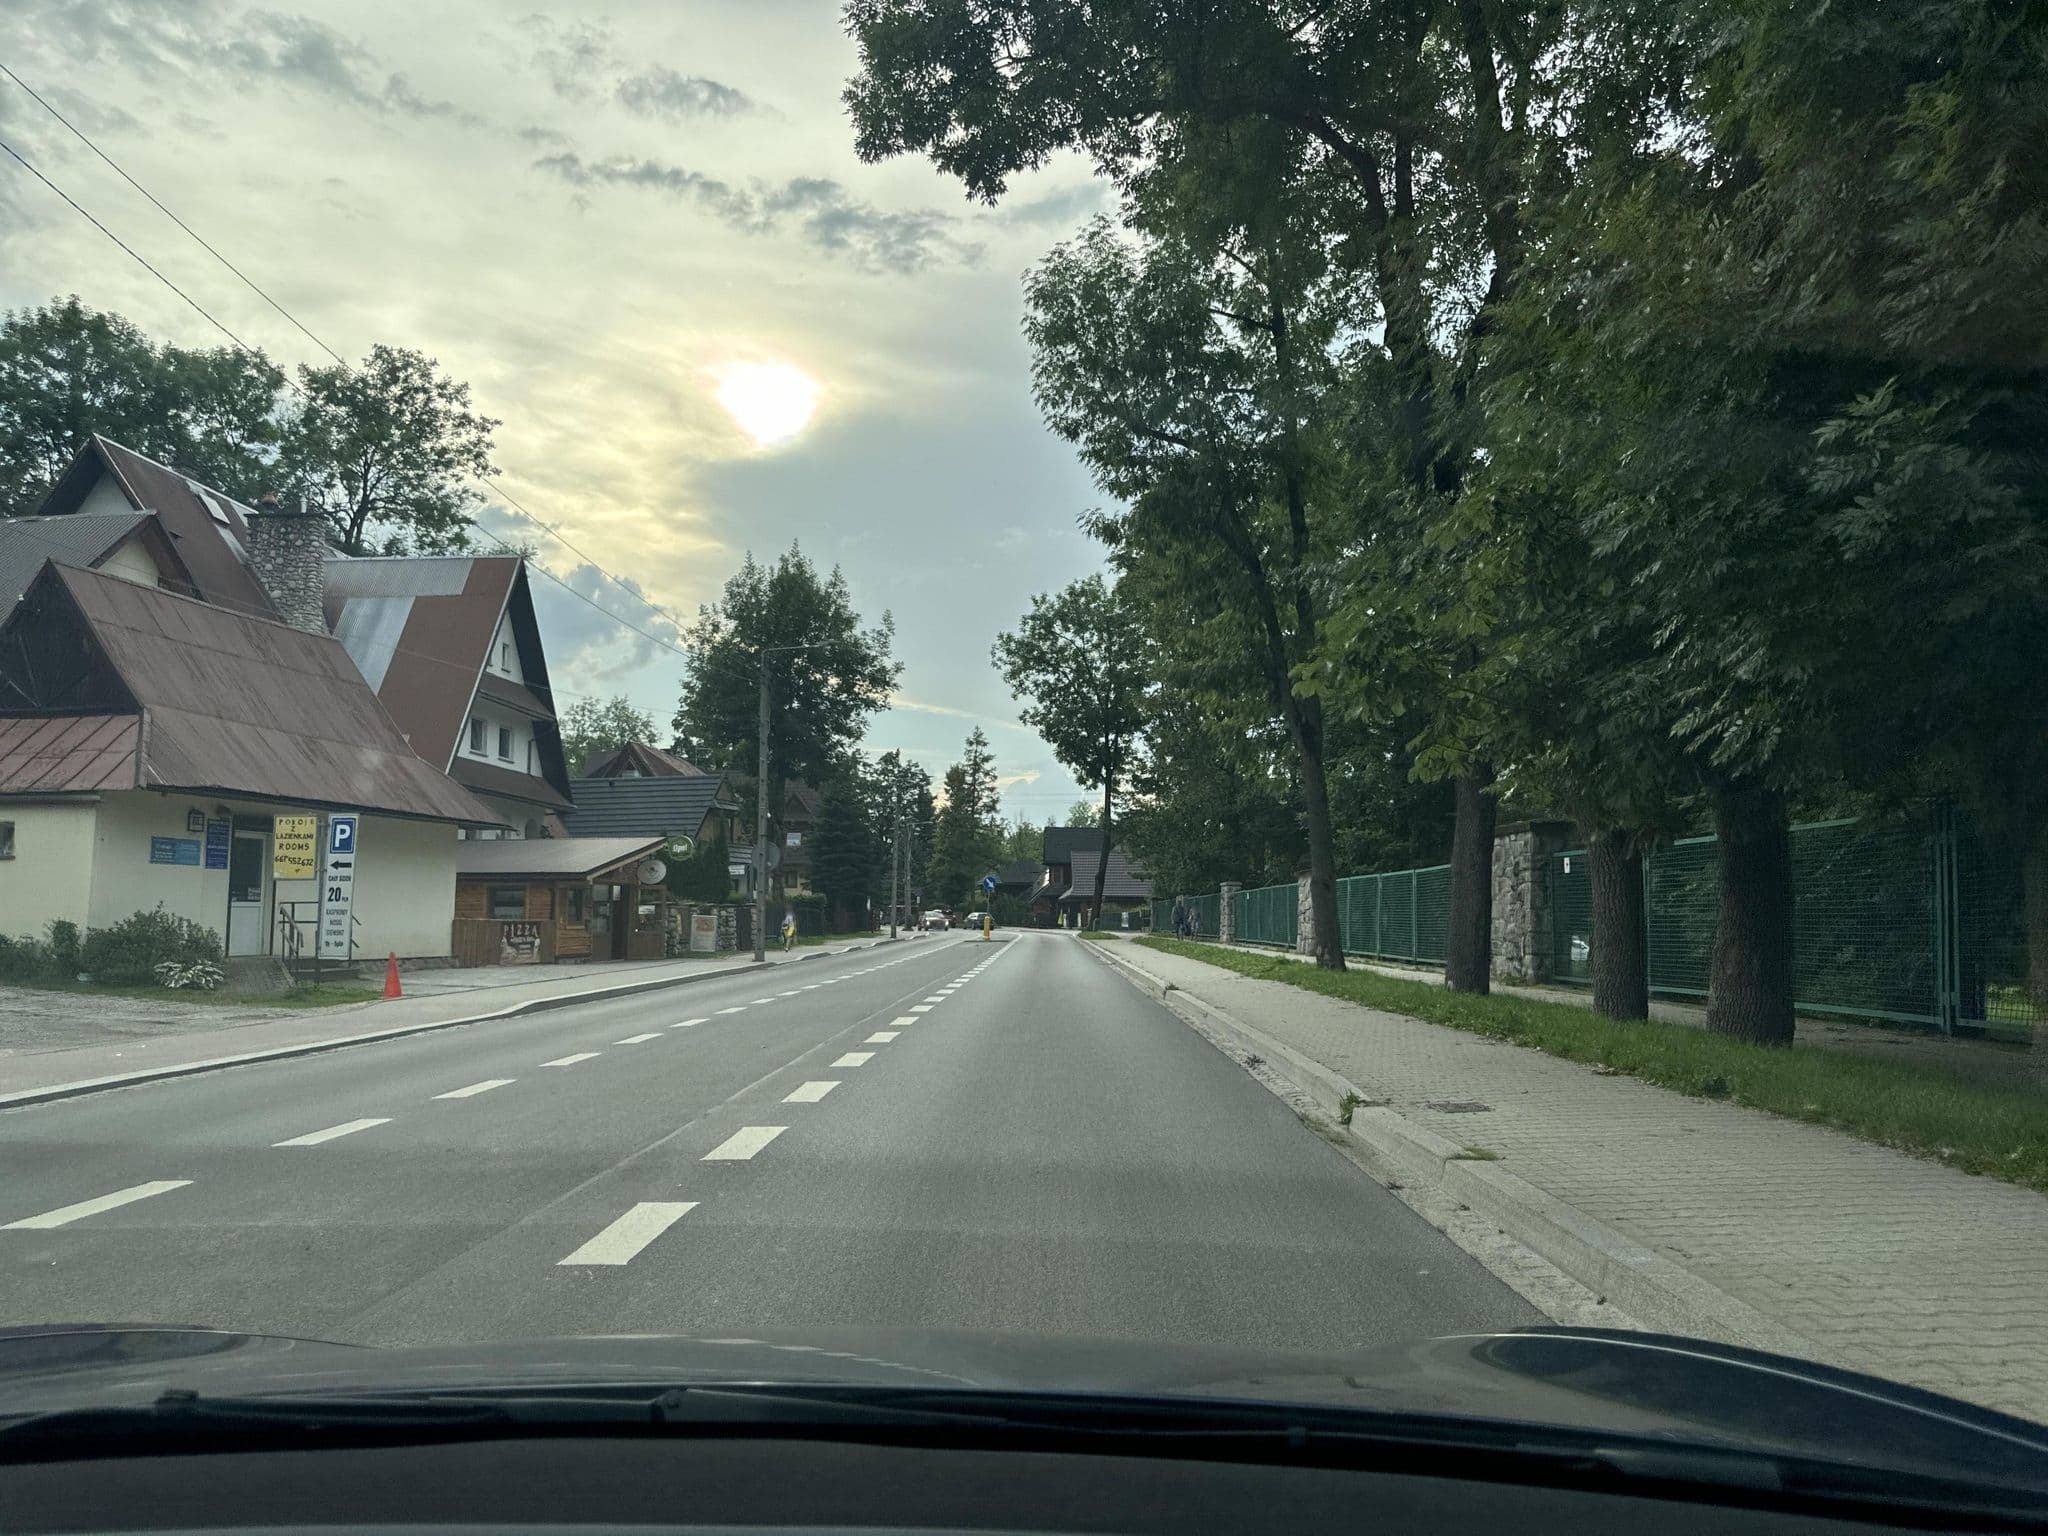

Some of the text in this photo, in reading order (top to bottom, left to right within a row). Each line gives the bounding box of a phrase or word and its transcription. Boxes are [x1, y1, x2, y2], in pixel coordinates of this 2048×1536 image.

[335, 824, 351, 847] P
[278, 842, 310, 851] ROOMS
[328, 887, 341, 902] 20
[503, 923, 539, 938] PIZZA
